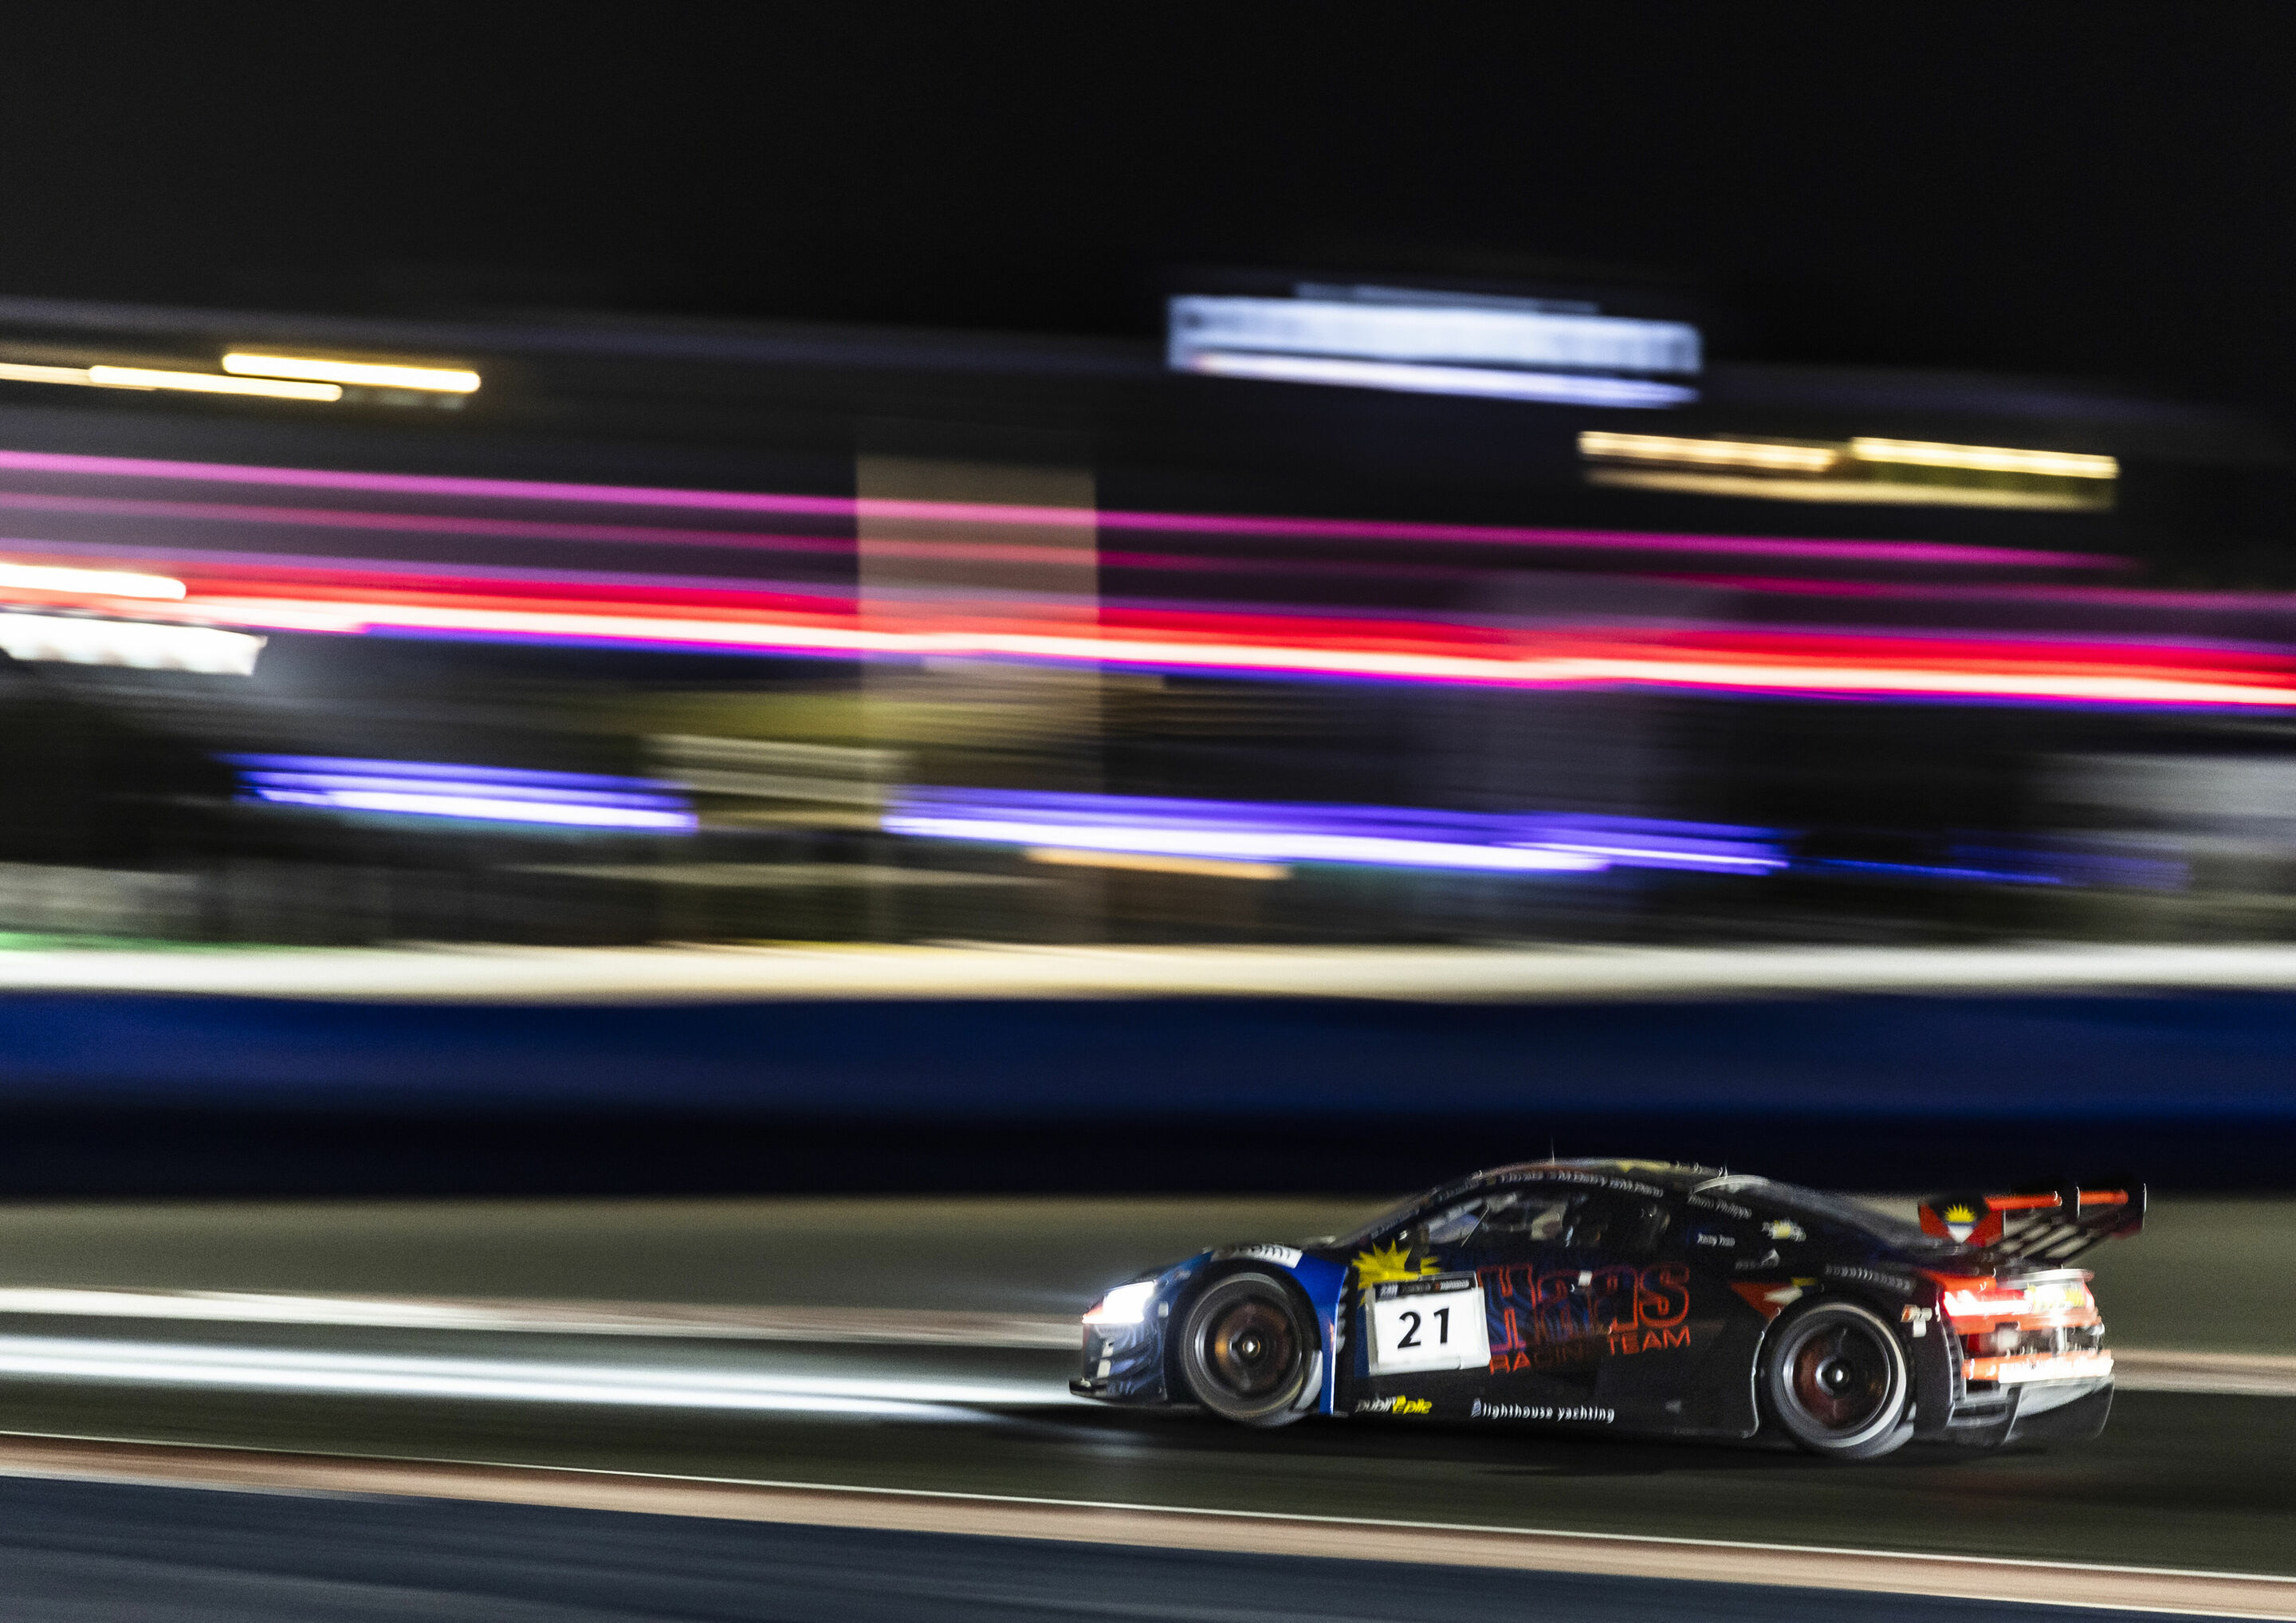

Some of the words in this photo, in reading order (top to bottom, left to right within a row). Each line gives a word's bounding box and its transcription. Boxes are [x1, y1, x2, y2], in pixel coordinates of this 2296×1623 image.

[1398, 1307, 1450, 1350] 21
[1608, 1325, 1691, 1356] TEAM
[1482, 1402, 1554, 1420] lighthouse
[1556, 1405, 1615, 1425] yachting
